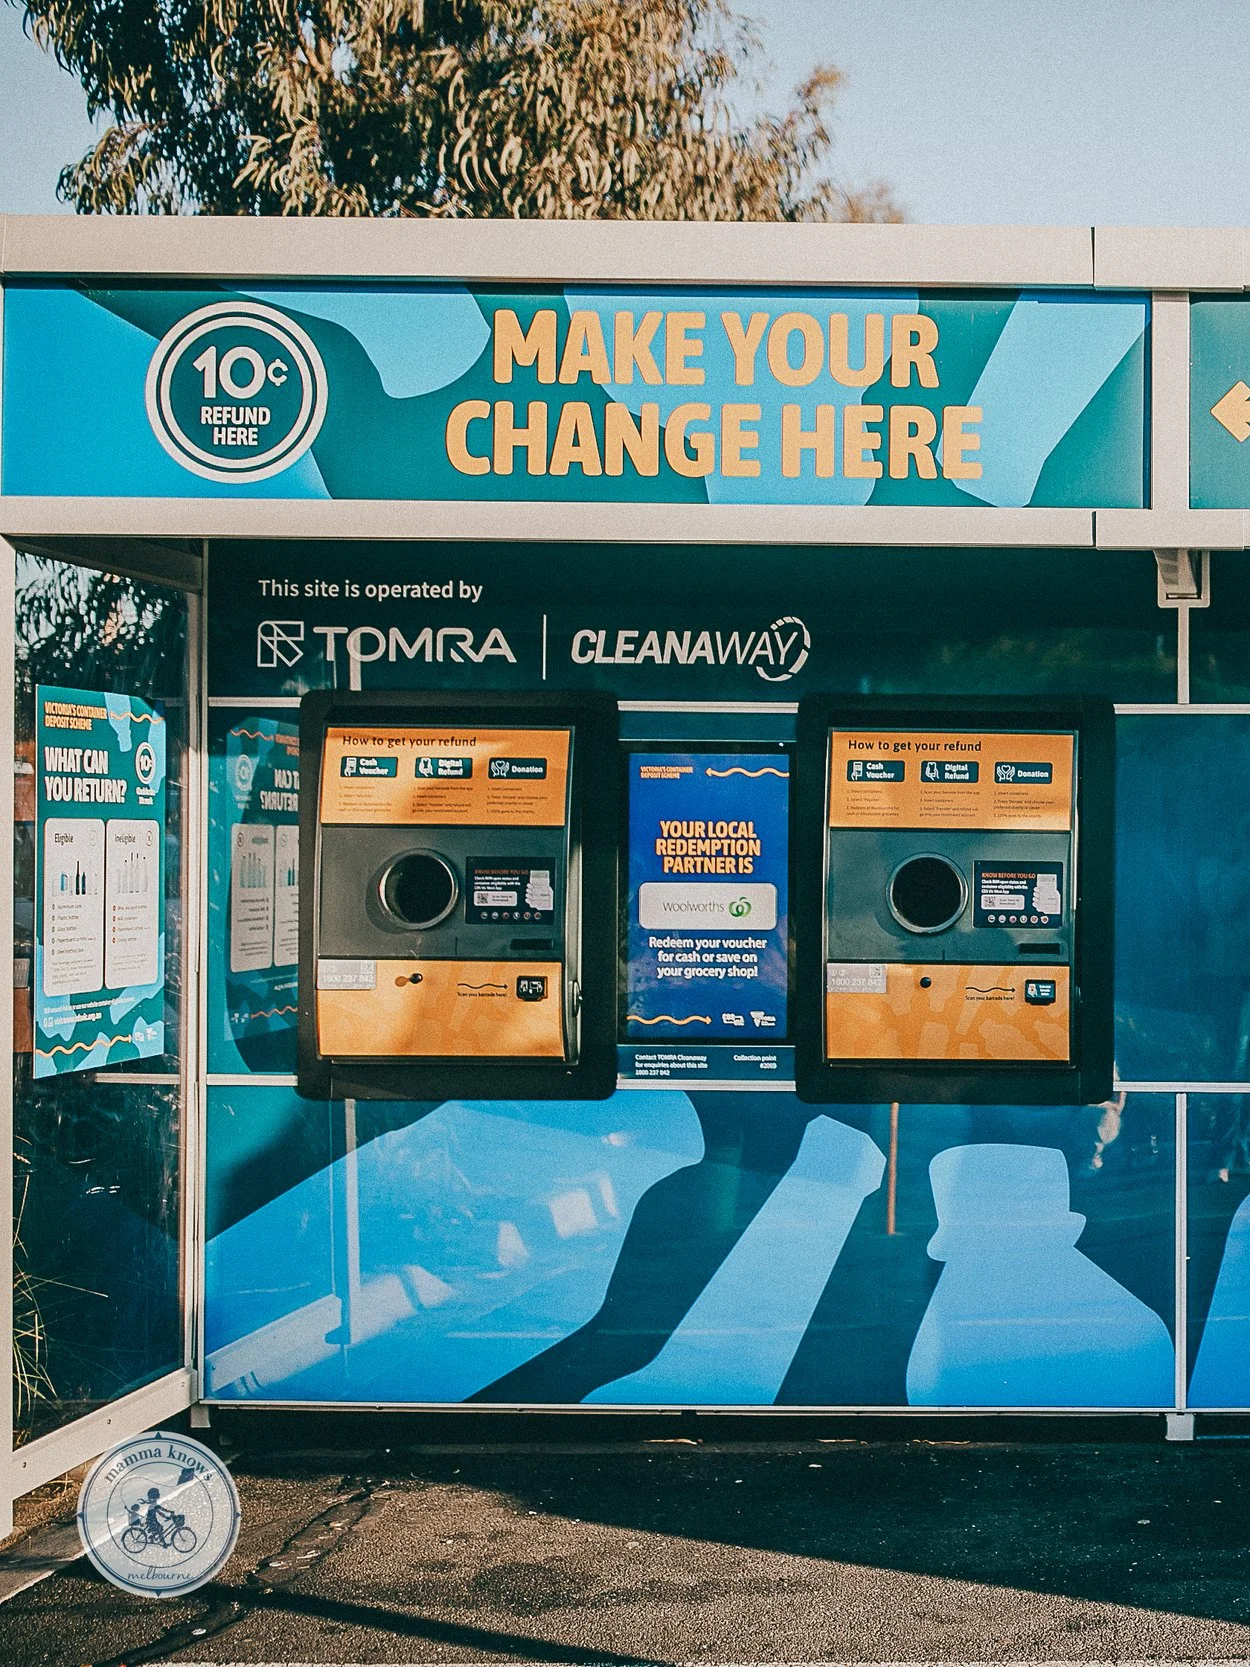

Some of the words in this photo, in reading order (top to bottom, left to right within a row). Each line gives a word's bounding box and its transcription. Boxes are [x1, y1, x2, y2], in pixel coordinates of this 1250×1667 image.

[493, 309, 706, 385] MAKE
[721, 312, 939, 388] YOUR
[192, 346, 289, 399] 10¢
[201, 406, 271, 425] REFUND
[213, 427, 258, 446] HERE
[445, 400, 761, 477] CHANGE
[781, 403, 983, 479] HERE
[259, 579, 300, 598] This
[304, 580, 340, 598] site
[344, 580, 360, 598] is
[364, 580, 455, 602] operated
[459, 581, 483, 603] by
[313, 626, 517, 664] TOMRA
[571, 629, 799, 665] CLEANAWAY
[343, 736, 368, 746] How
[373, 737, 384, 746] to
[388, 737, 406, 748] get
[409, 738, 435, 749] your
[439, 736, 476, 746] refund
[848, 740, 874, 750] How
[878, 741, 889, 750] to
[893, 741, 911, 752] get
[915, 743, 940, 753] your
[944, 741, 981, 751] refund
[44, 747, 82, 772] WHAT
[83, 749, 109, 775] CAN
[360, 758, 377, 766] Cash
[438, 759, 462, 769] Digital
[866, 762, 883, 770] Cash
[945, 764, 968, 772] Digital
[359, 767, 389, 775] Voucher
[866, 771, 895, 779] Voucher
[1018, 770, 1049, 778] Donation
[44, 776, 73, 802] YOU
[74, 778, 127, 803] RETURN?
[660, 821, 705, 838] YOUR
[708, 821, 757, 838] LOCAL
[54, 833, 74, 845] Eligible
[656, 839, 761, 856] REDEMPTION
[663, 857, 736, 873] PARTNER
[738, 857, 754, 874] IS
[663, 901, 724, 912] Woolworths
[648, 937, 694, 949] Redeem
[695, 939, 722, 950] your
[722, 937, 767, 949] voucher
[657, 952, 674, 962] for
[675, 952, 701, 963] cash
[703, 954, 715, 962] or
[715, 954, 741, 963] save
[742, 954, 757, 963] on
[657, 968, 684, 979] your
[684, 968, 727, 980] grocery
[728, 966, 758, 979] shop!
